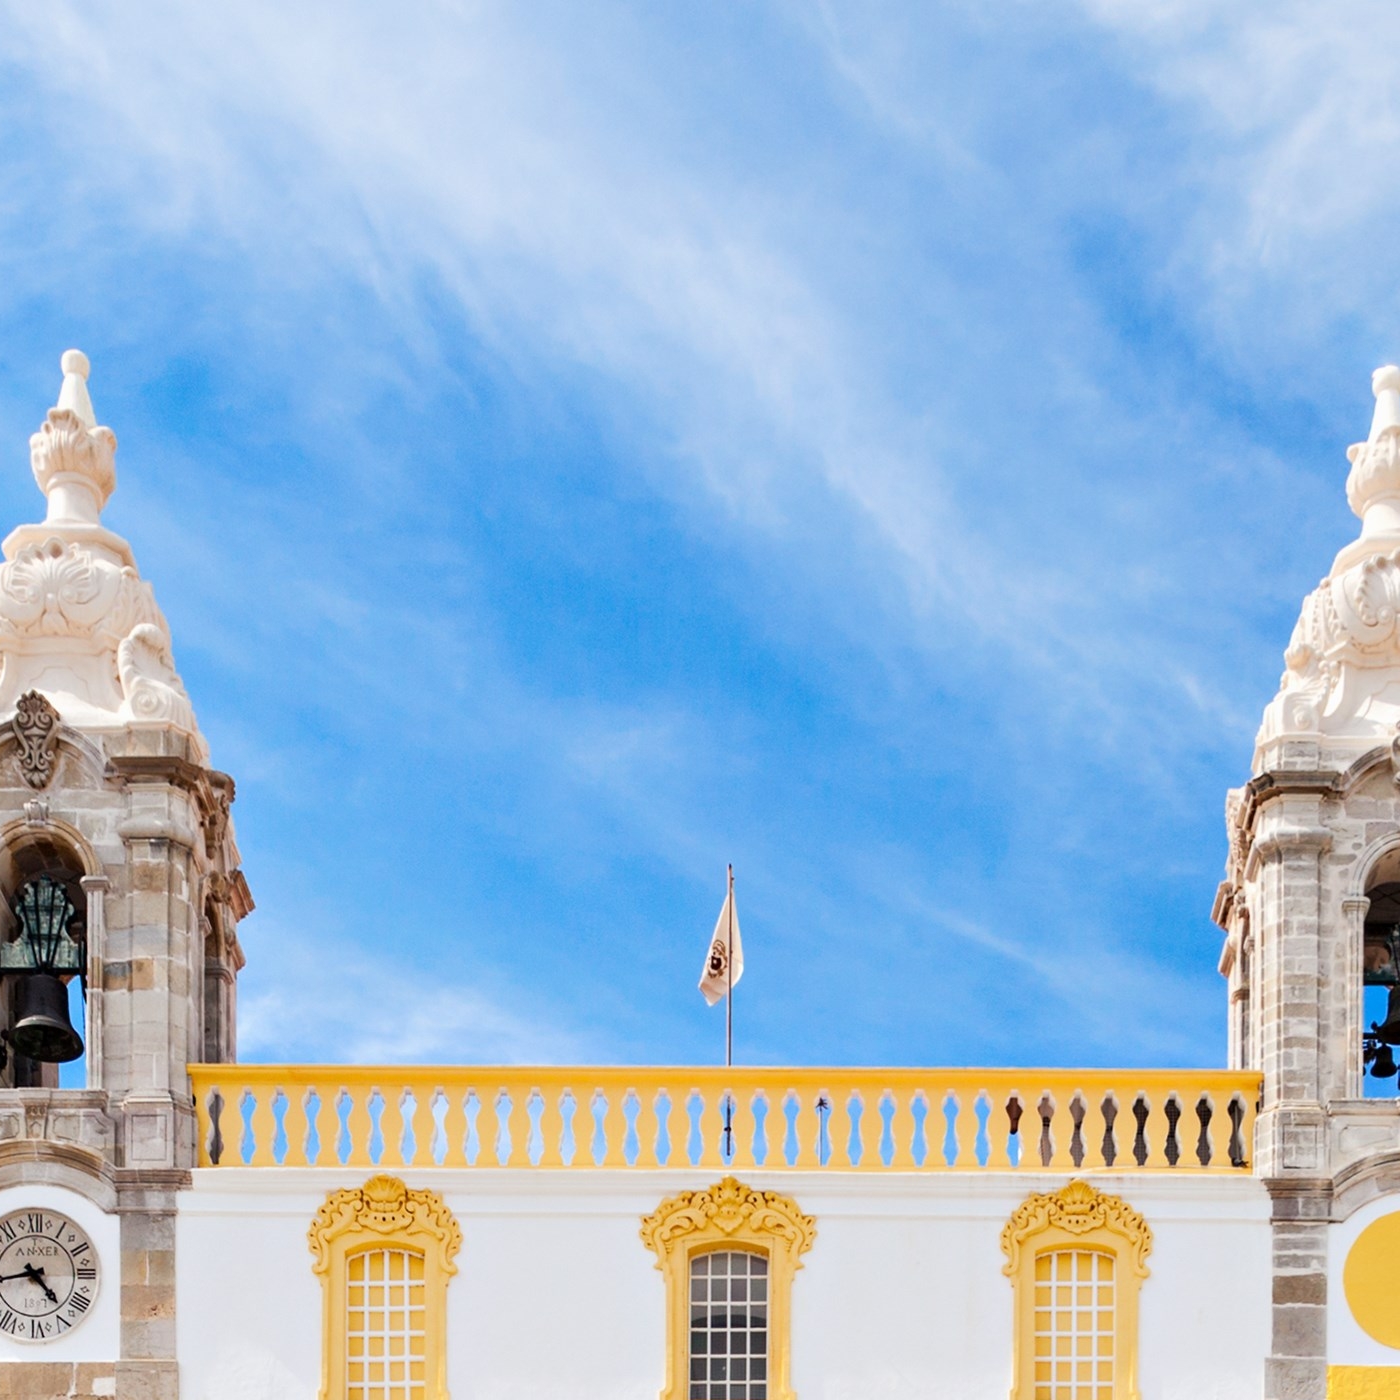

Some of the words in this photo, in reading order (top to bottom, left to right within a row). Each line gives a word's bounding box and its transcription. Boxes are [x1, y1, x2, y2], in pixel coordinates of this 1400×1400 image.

[28, 1214, 43, 1233] XII
[70, 1242, 89, 1257] II
[77, 1268, 96, 1280] III
